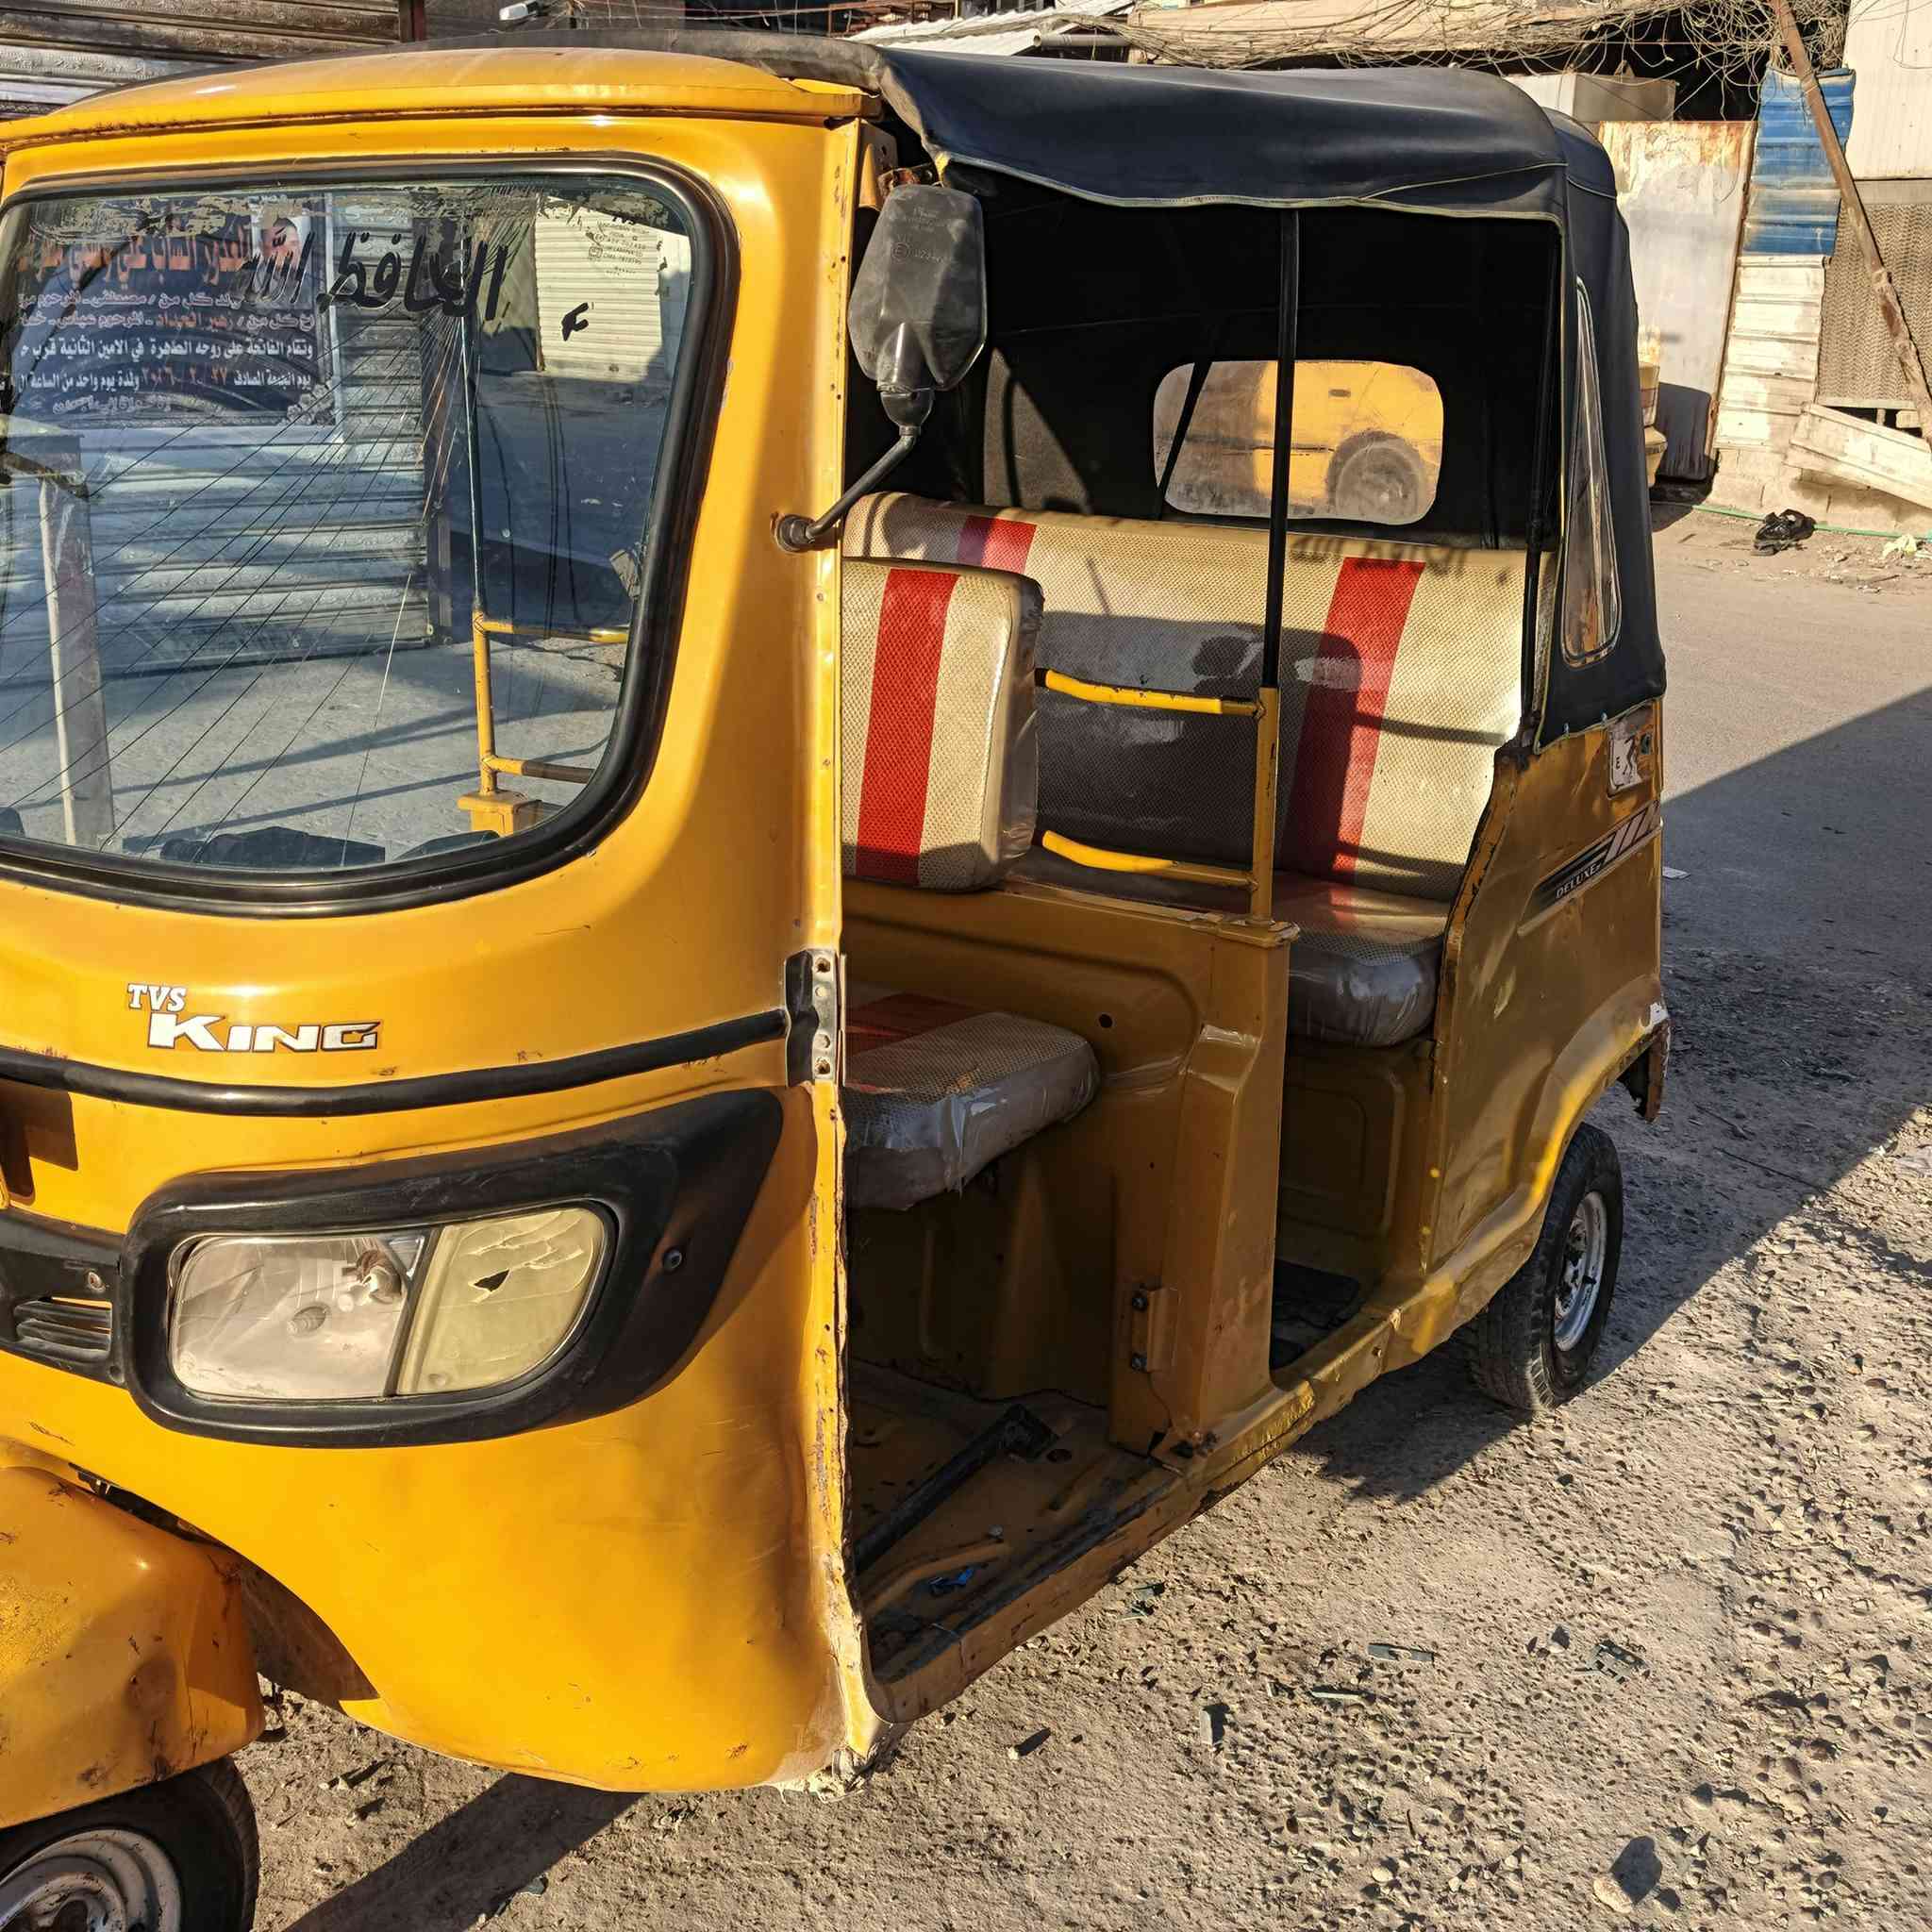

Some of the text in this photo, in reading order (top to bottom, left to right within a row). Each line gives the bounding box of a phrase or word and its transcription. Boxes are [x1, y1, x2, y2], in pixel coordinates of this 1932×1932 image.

[315, 230, 509, 322] الحافظ
[90, 289, 147, 308] مصطفى
[158, 291, 181, 309] من
[182, 291, 213, 310] كل
[98, 310, 144, 329] المرحوم
[245, 313, 268, 333] من
[269, 314, 298, 331] كل
[31, 337, 57, 360] قرب
[58, 334, 95, 360] الثانية
[130, 337, 144, 362] في
[194, 341, 221, 359] روحه
[222, 341, 243, 359] على
[244, 337, 284, 356] الفاتحة
[285, 338, 313, 359] وتقام
[29, 371, 59, 389] الساعة
[61, 372, 74, 392] من
[75, 372, 98, 392] واحد
[99, 375, 116, 392] يوم
[117, 369, 140, 392] ولمدة
[264, 368, 294, 391] الجمعة
[294, 372, 312, 391] يوم
[127, 983, 187, 1012] TVS
